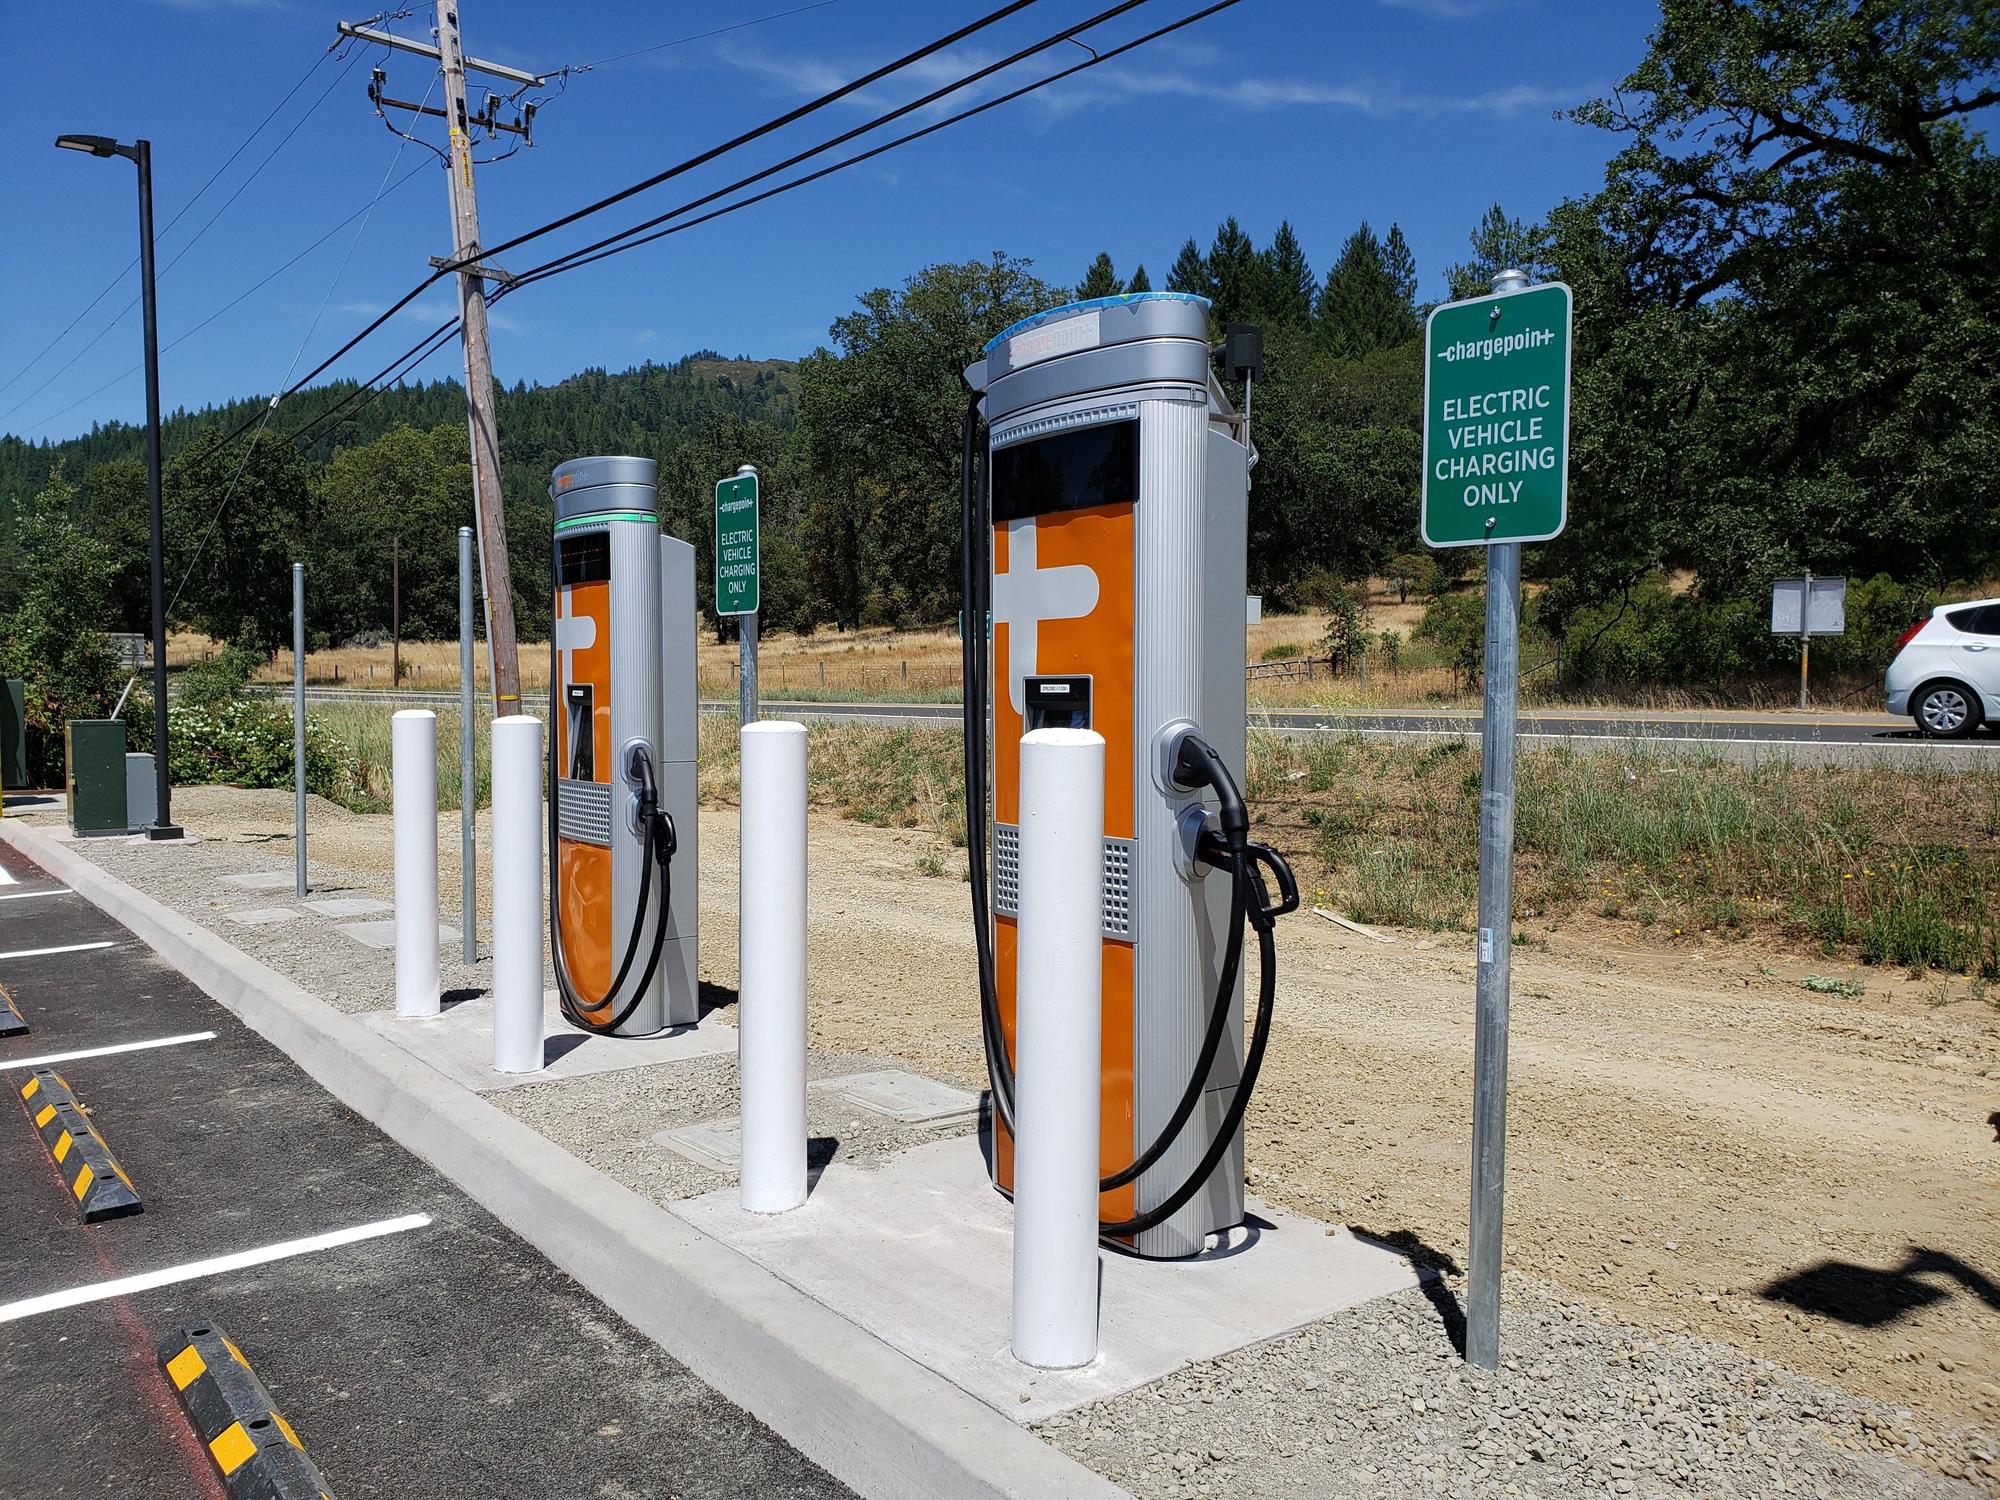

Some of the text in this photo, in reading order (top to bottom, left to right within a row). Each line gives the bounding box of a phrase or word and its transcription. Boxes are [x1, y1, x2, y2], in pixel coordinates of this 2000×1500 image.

[1443, 385, 1550, 421] ELECTRIC
[1448, 417, 1543, 449] VEHICLE
[1435, 446, 1555, 480] CHARGING
[1463, 480, 1524, 507] ONLY
[721, 529, 754, 546] ELECTRIC
[723, 546, 752, 561] VEHICLE
[719, 562, 756, 578] CHARGING
[728, 580, 747, 594] ONLY
